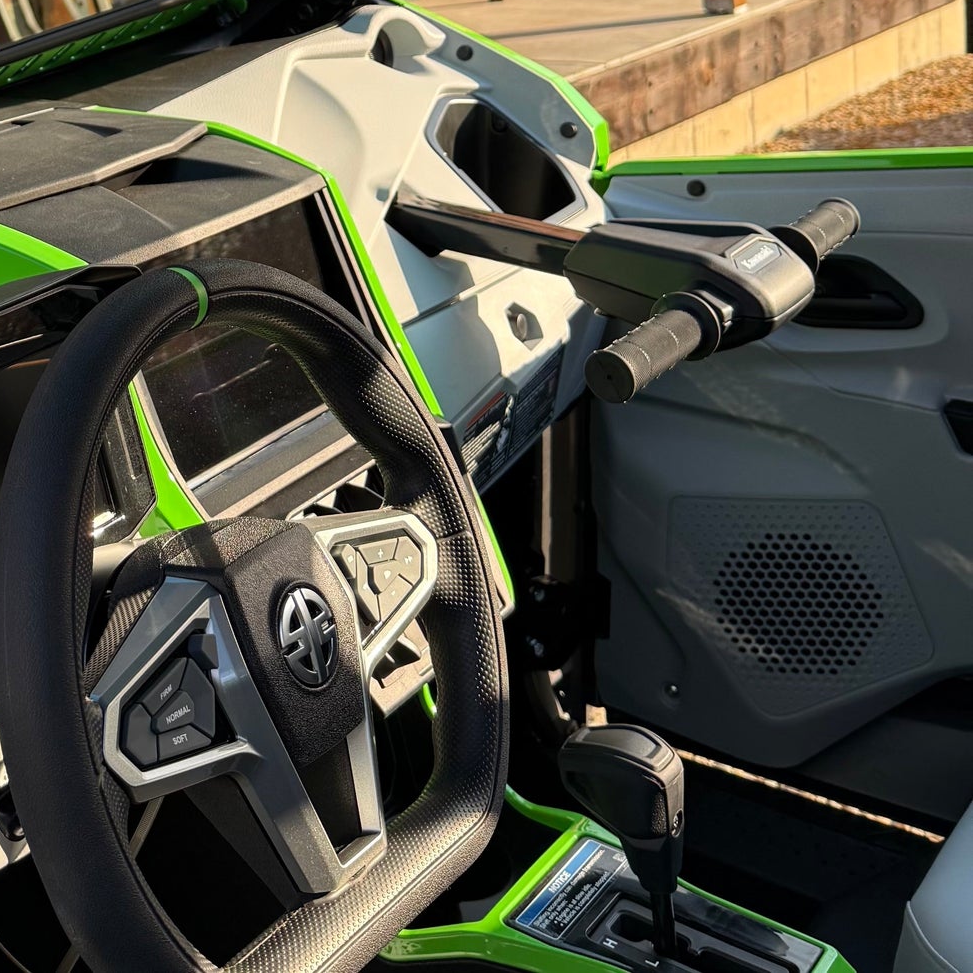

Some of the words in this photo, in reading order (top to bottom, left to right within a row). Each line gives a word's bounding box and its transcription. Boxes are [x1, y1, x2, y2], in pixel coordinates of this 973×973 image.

[160, 684, 172, 700] FIRM
[166, 705, 191, 725] NORMAL
[172, 733, 188, 745] SOFT
[548, 870, 572, 894] NOTICE
[603, 938, 618, 949] H
